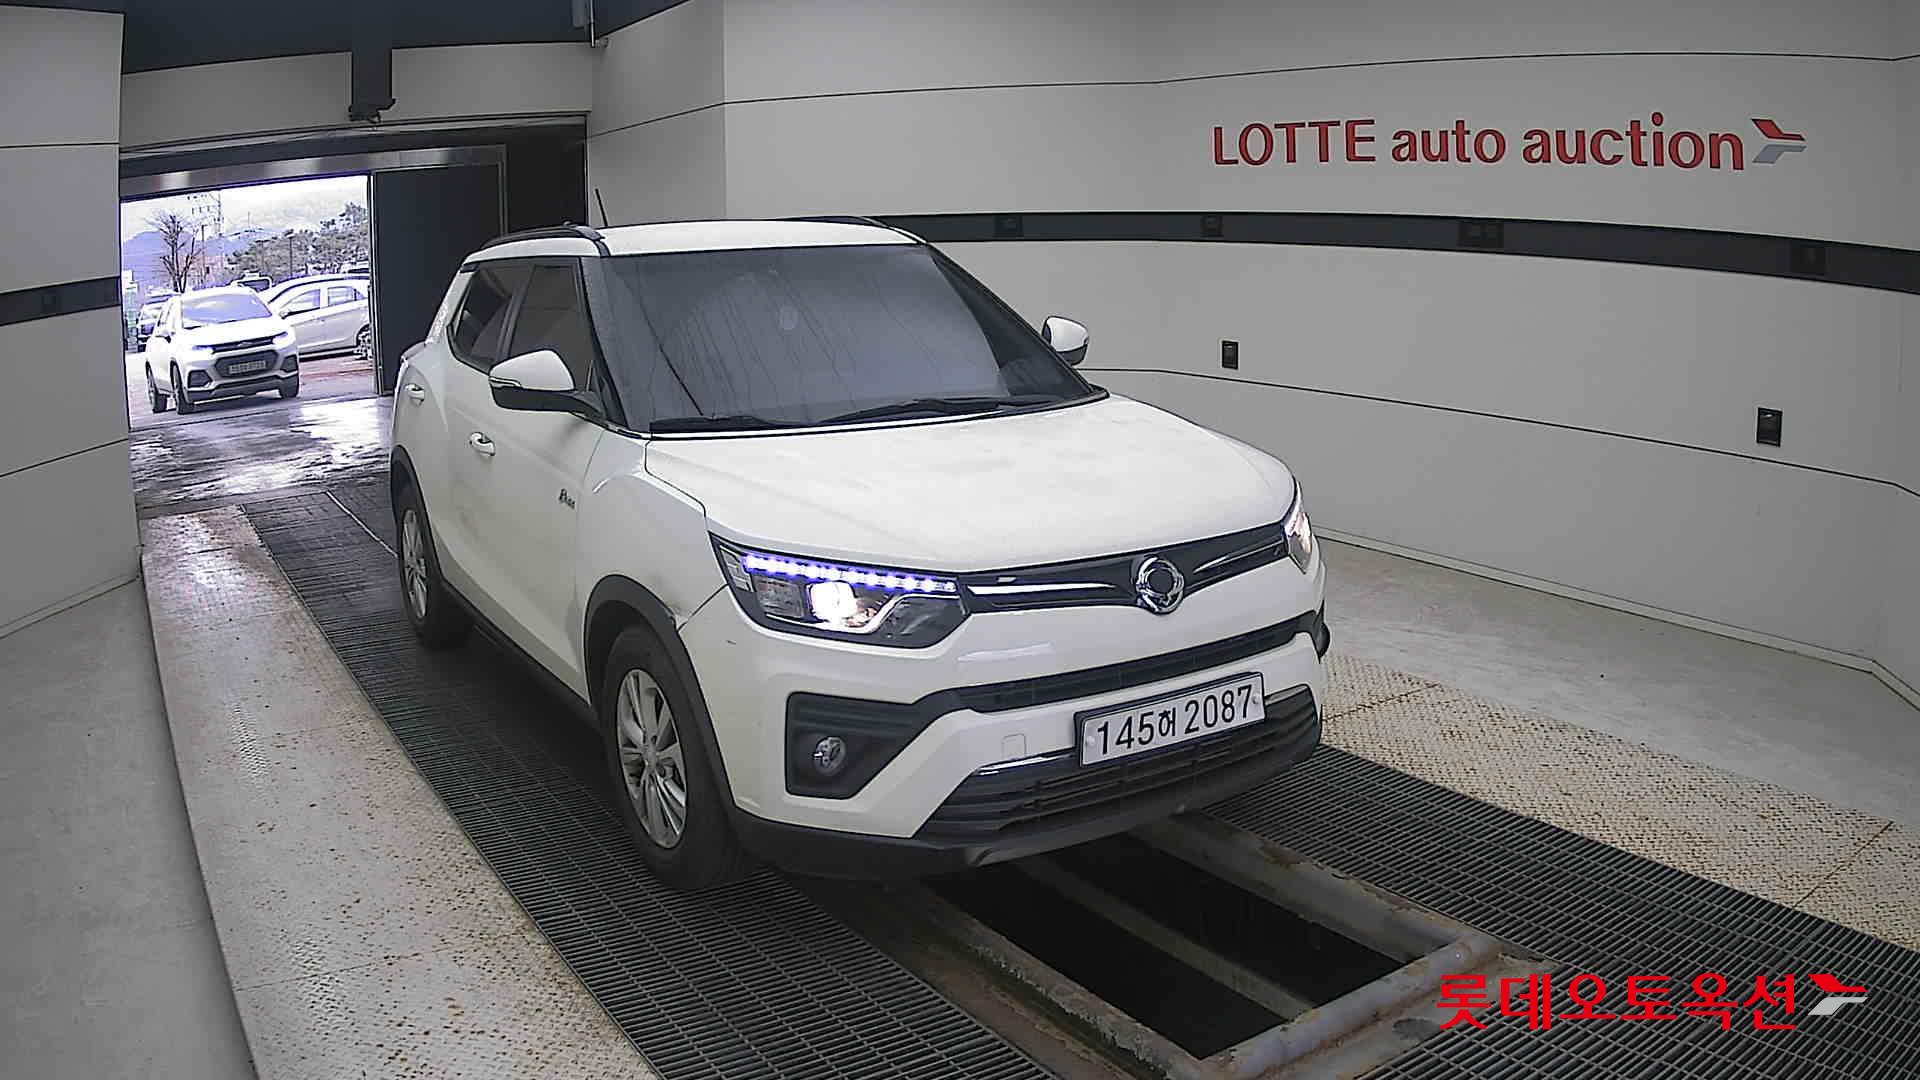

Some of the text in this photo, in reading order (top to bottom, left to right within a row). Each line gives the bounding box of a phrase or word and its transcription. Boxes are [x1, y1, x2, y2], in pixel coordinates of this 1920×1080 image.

[1212, 111, 1745, 171] LOTTE auto auction
[1184, 684, 1253, 735] 2087
